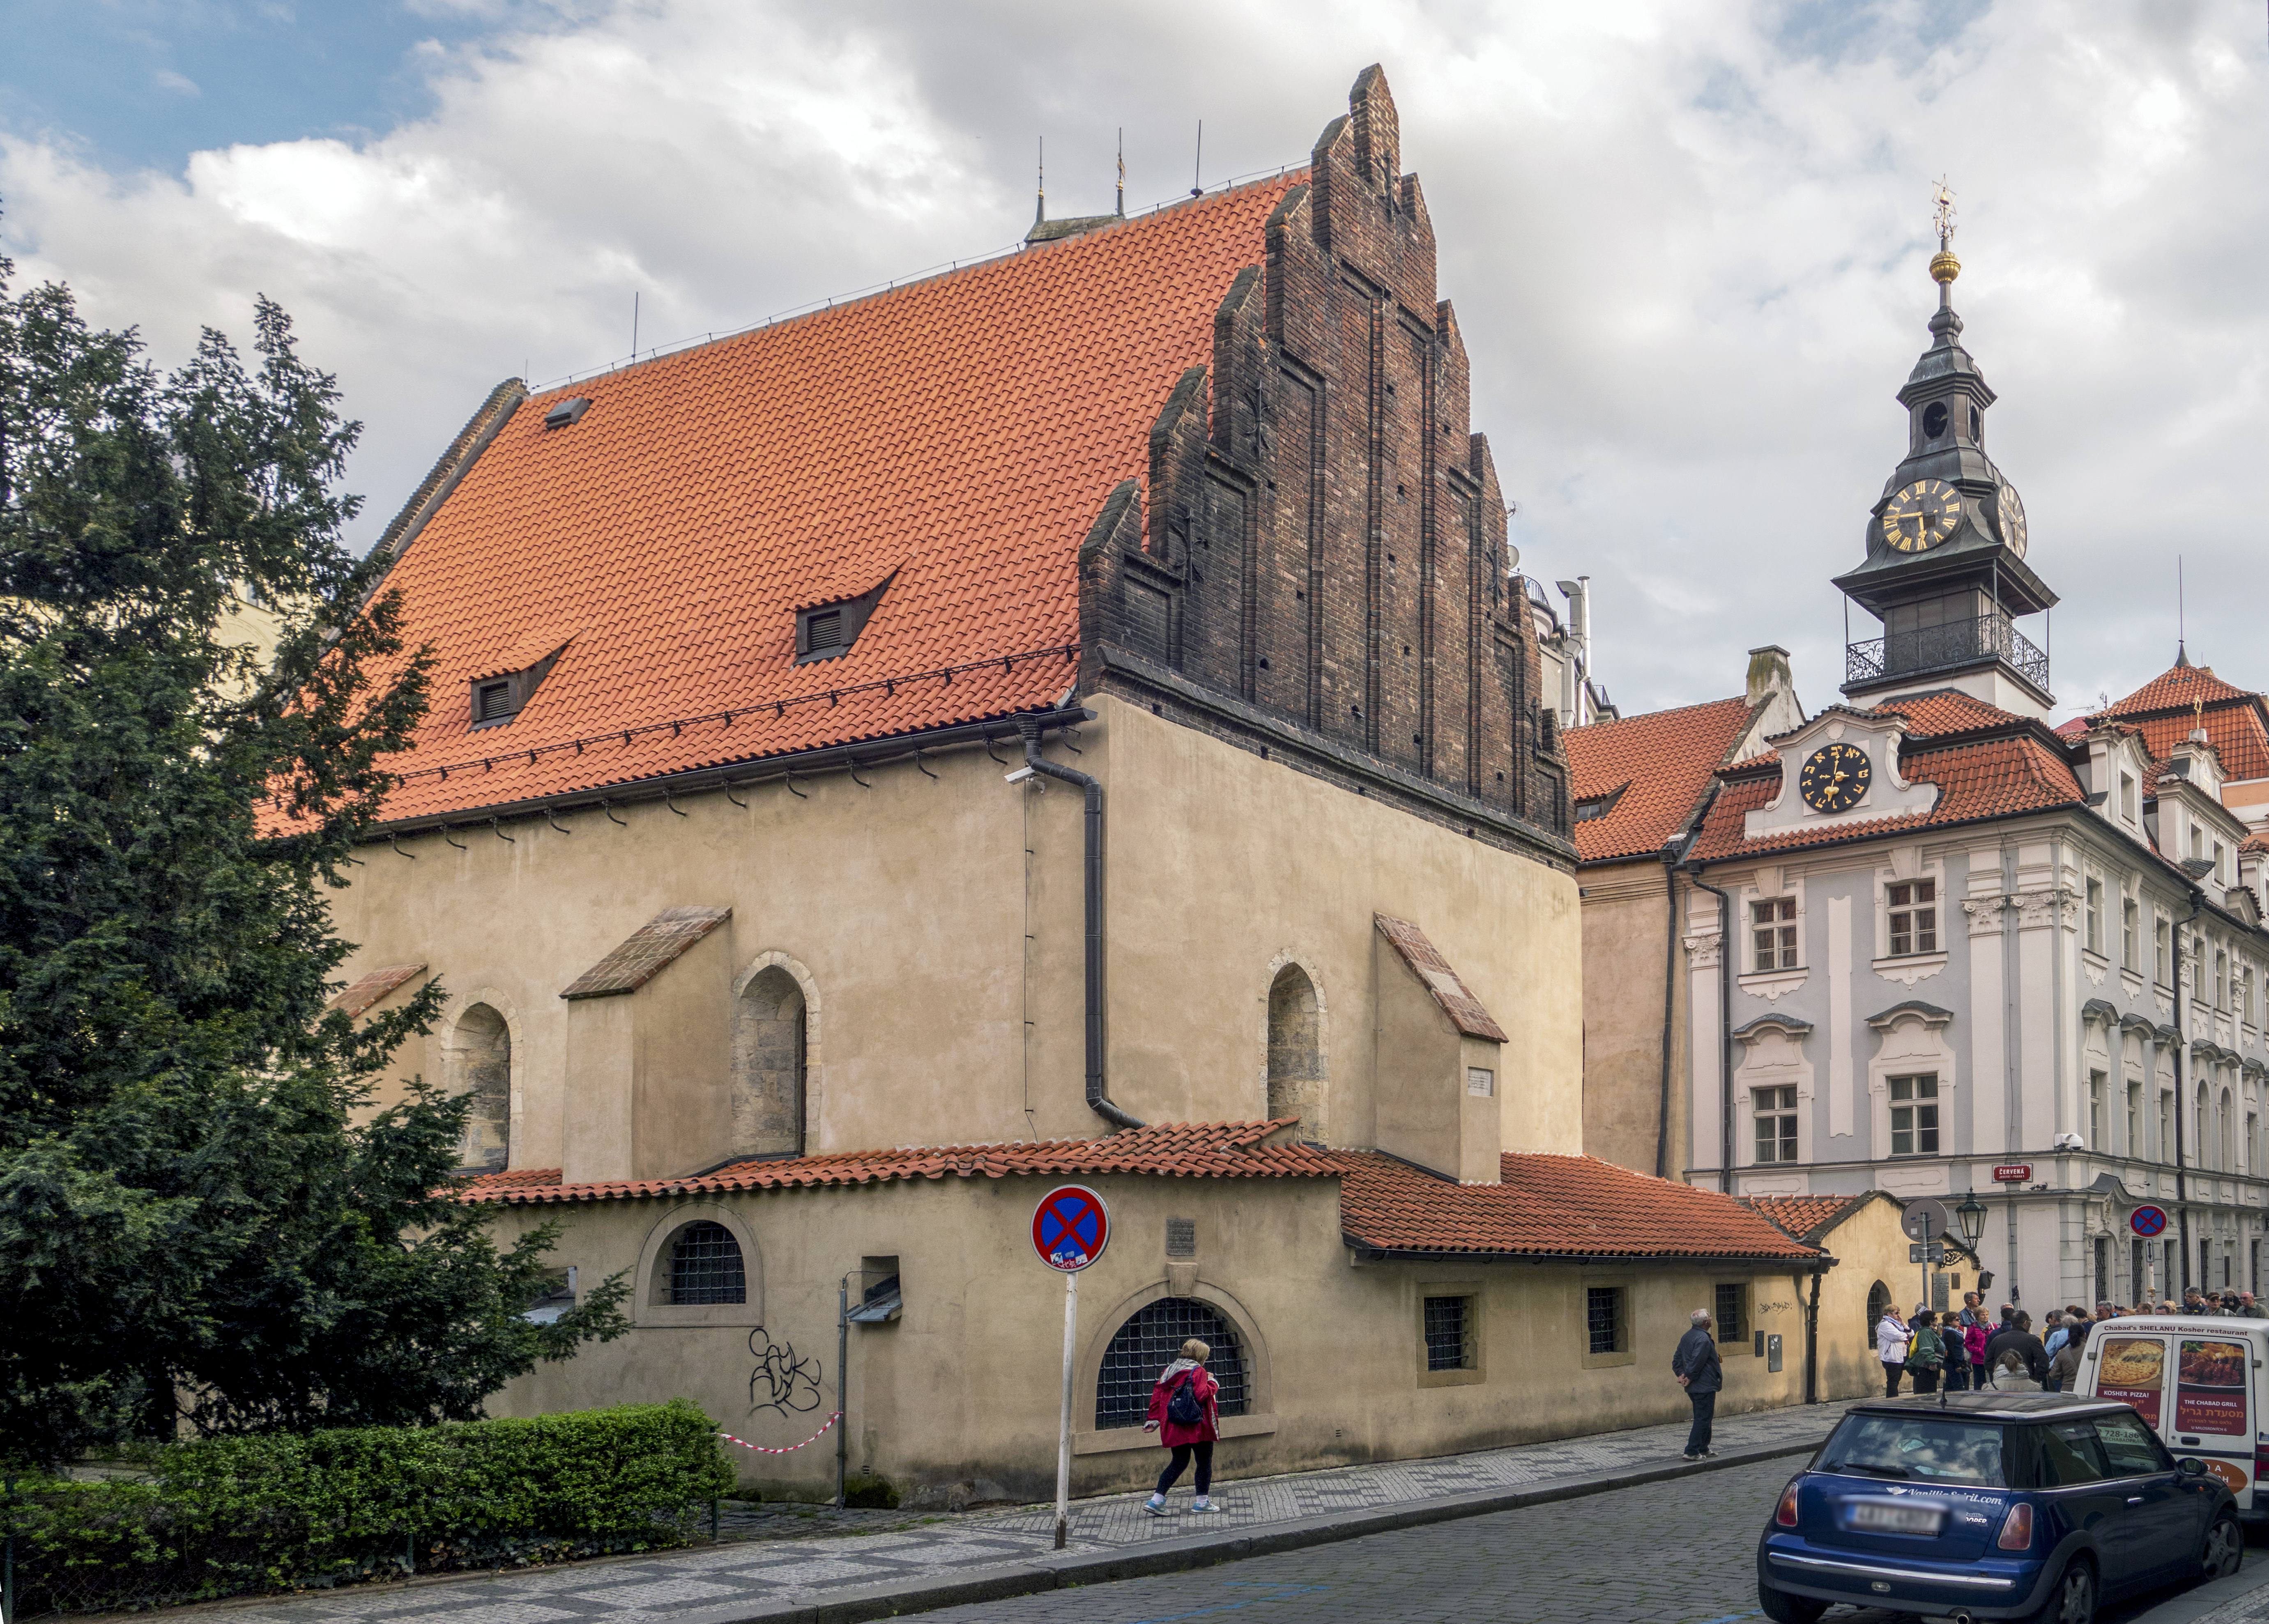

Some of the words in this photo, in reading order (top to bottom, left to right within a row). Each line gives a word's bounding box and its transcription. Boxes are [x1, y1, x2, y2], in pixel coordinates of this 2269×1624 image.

[1915, 481, 1926, 495] XII
[1931, 481, 1941, 494] I
[1897, 489, 1911, 504] XI
[1941, 488, 1955, 501] II
[1887, 504, 1901, 513] X
[1946, 502, 1960, 513] III
[1942, 518, 1956, 529] IV
[1887, 529, 1902, 545] VIII
[1933, 531, 1944, 543] V
[1899, 537, 1912, 550] VII
[2180, 1405, 2202, 1415] גריל
[2205, 1409, 2244, 1418] מסעדת
